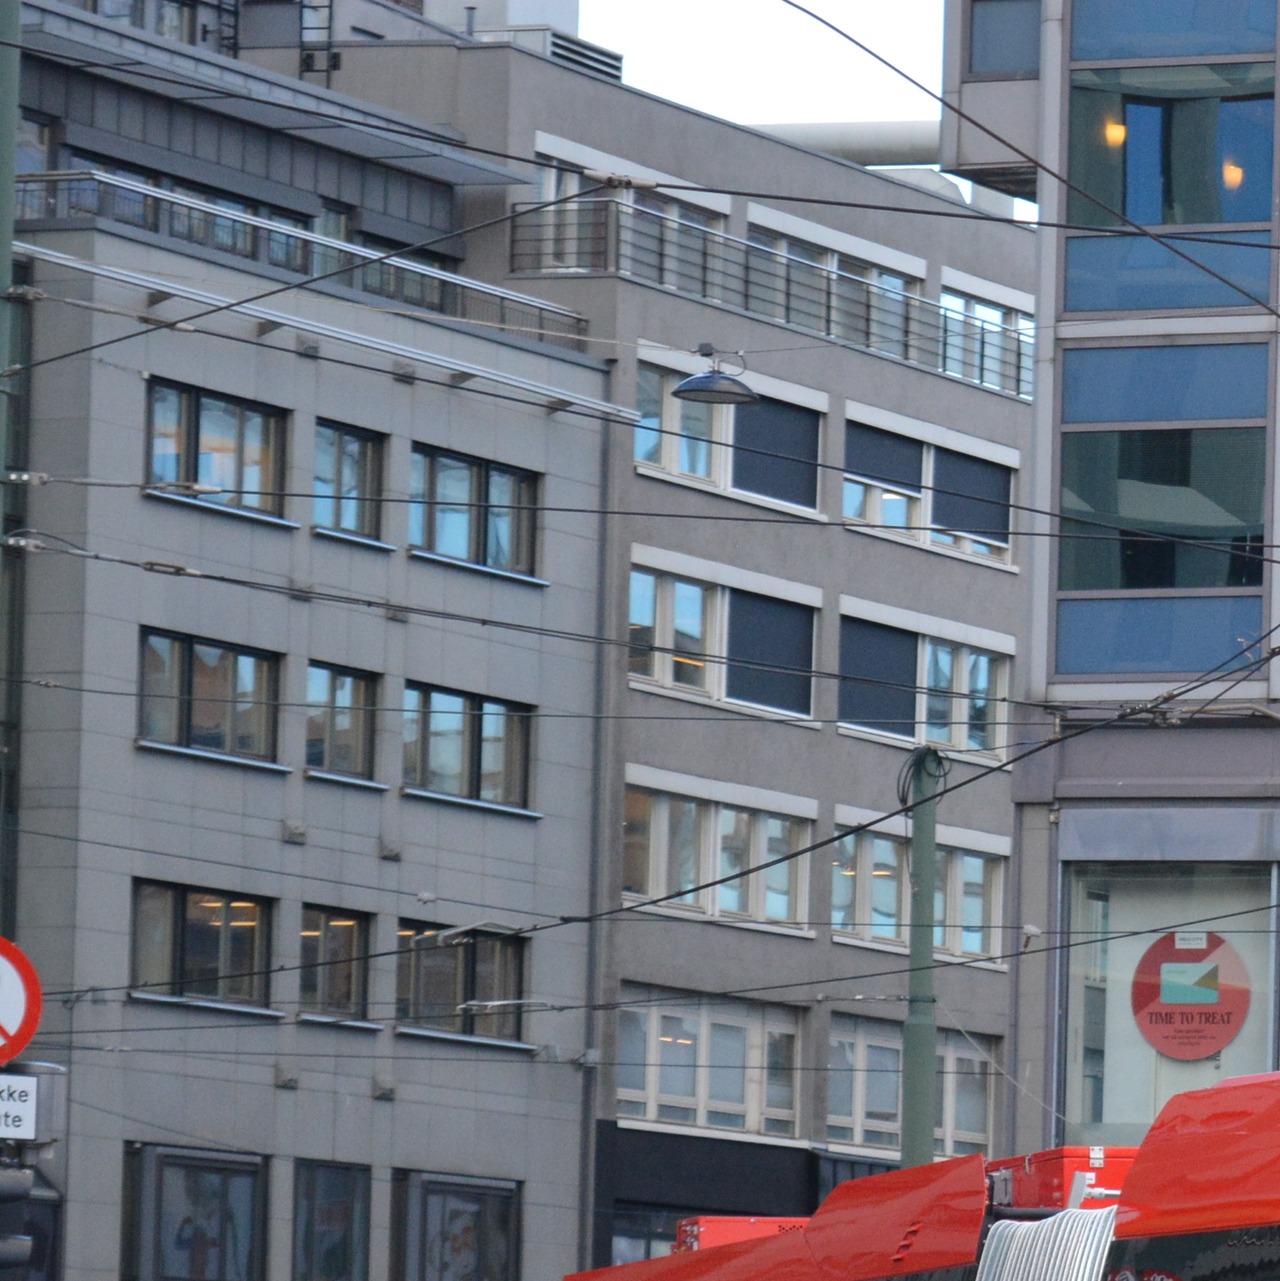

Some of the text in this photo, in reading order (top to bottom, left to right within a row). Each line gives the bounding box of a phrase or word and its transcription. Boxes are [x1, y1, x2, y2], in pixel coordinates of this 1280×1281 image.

[1148, 1012, 1233, 1025] TIME TO TREAT
[0, 1112, 22, 1128] te
